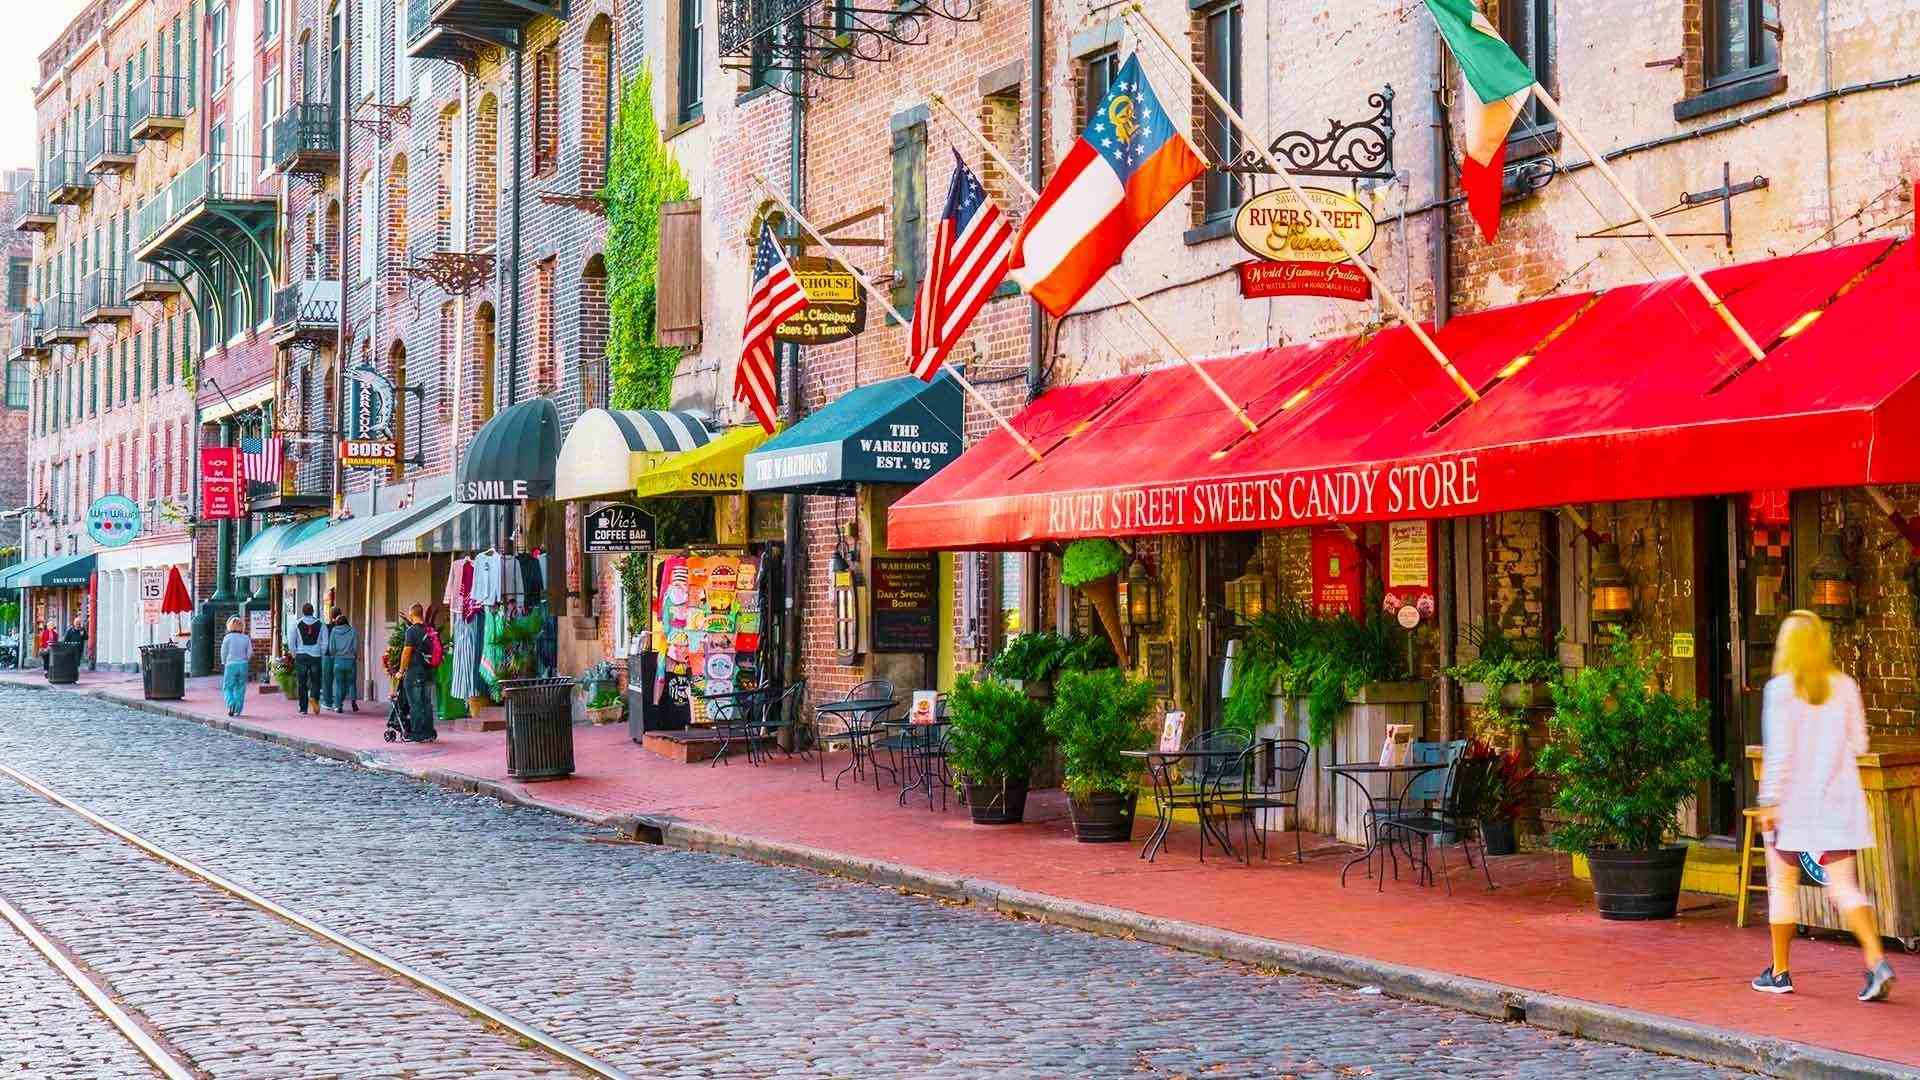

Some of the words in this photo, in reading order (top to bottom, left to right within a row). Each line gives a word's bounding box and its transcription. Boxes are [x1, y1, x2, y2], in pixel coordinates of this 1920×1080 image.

[1249, 208, 1299, 226] RIVER
[1248, 265, 1284, 282] World
[800, 277, 853, 290] EHOUSE
[808, 308, 857, 324] Cheapest
[776, 322, 802, 335] Beer
[819, 323, 849, 336] Town
[889, 424, 920, 438] THE
[348, 442, 396, 457] BOB'S
[860, 438, 949, 455] WAREHOUSE
[756, 457, 774, 481] THE
[774, 451, 829, 479] WAREHOUSE
[876, 456, 907, 469] EST.
[911, 457, 932, 470] '92
[690, 472, 738, 488] SONA'S
[467, 479, 529, 500] SMILE
[1049, 494, 1104, 534] RIVER
[1110, 486, 1188, 530] STREET
[1193, 477, 1284, 526] SWEETS
[1288, 469, 1381, 520] CANDY
[1387, 456, 1481, 513] STORE
[606, 508, 638, 529] Vic's
[594, 529, 628, 540] COFFEE
[629, 529, 647, 540] BAR
[144, 585, 160, 597] 15
[1673, 579, 1692, 598] 13
